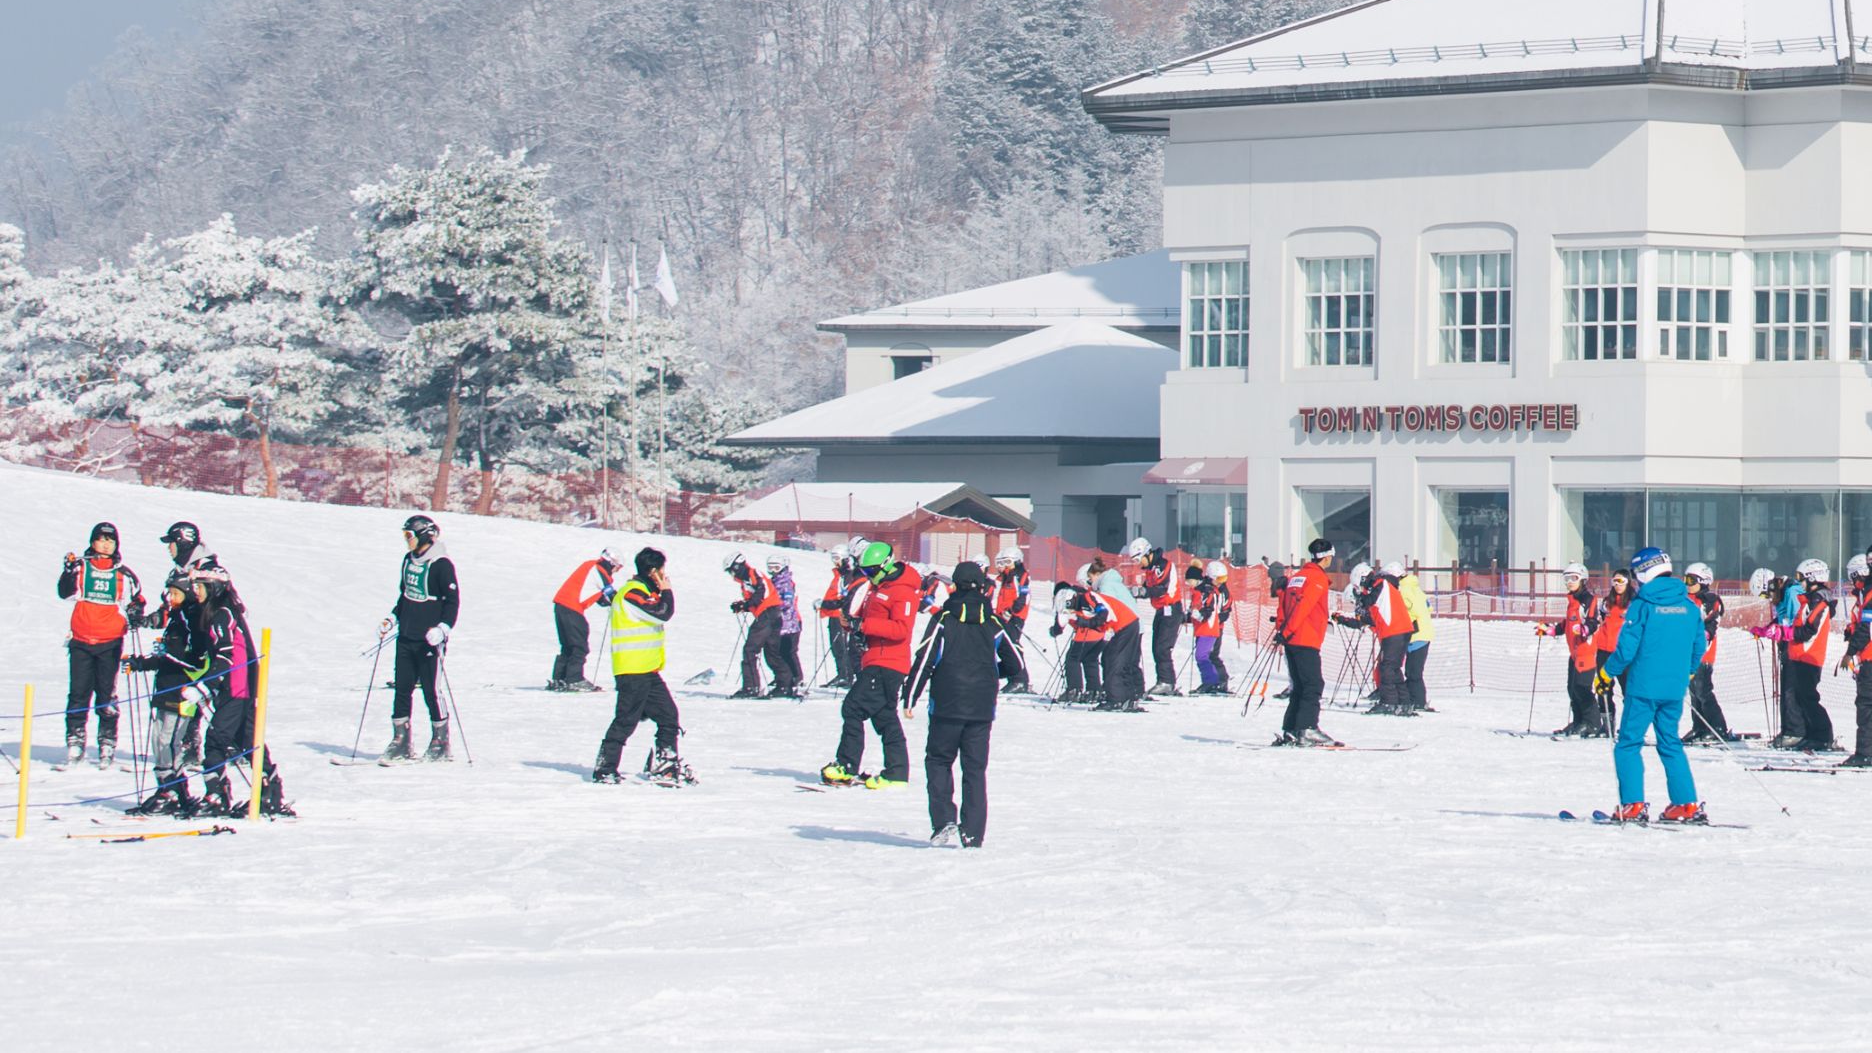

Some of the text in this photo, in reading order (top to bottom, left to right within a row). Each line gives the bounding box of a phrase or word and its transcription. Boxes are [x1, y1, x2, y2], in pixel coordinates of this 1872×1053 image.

[1299, 403, 1578, 433] TOM N TOMS COFFEE
